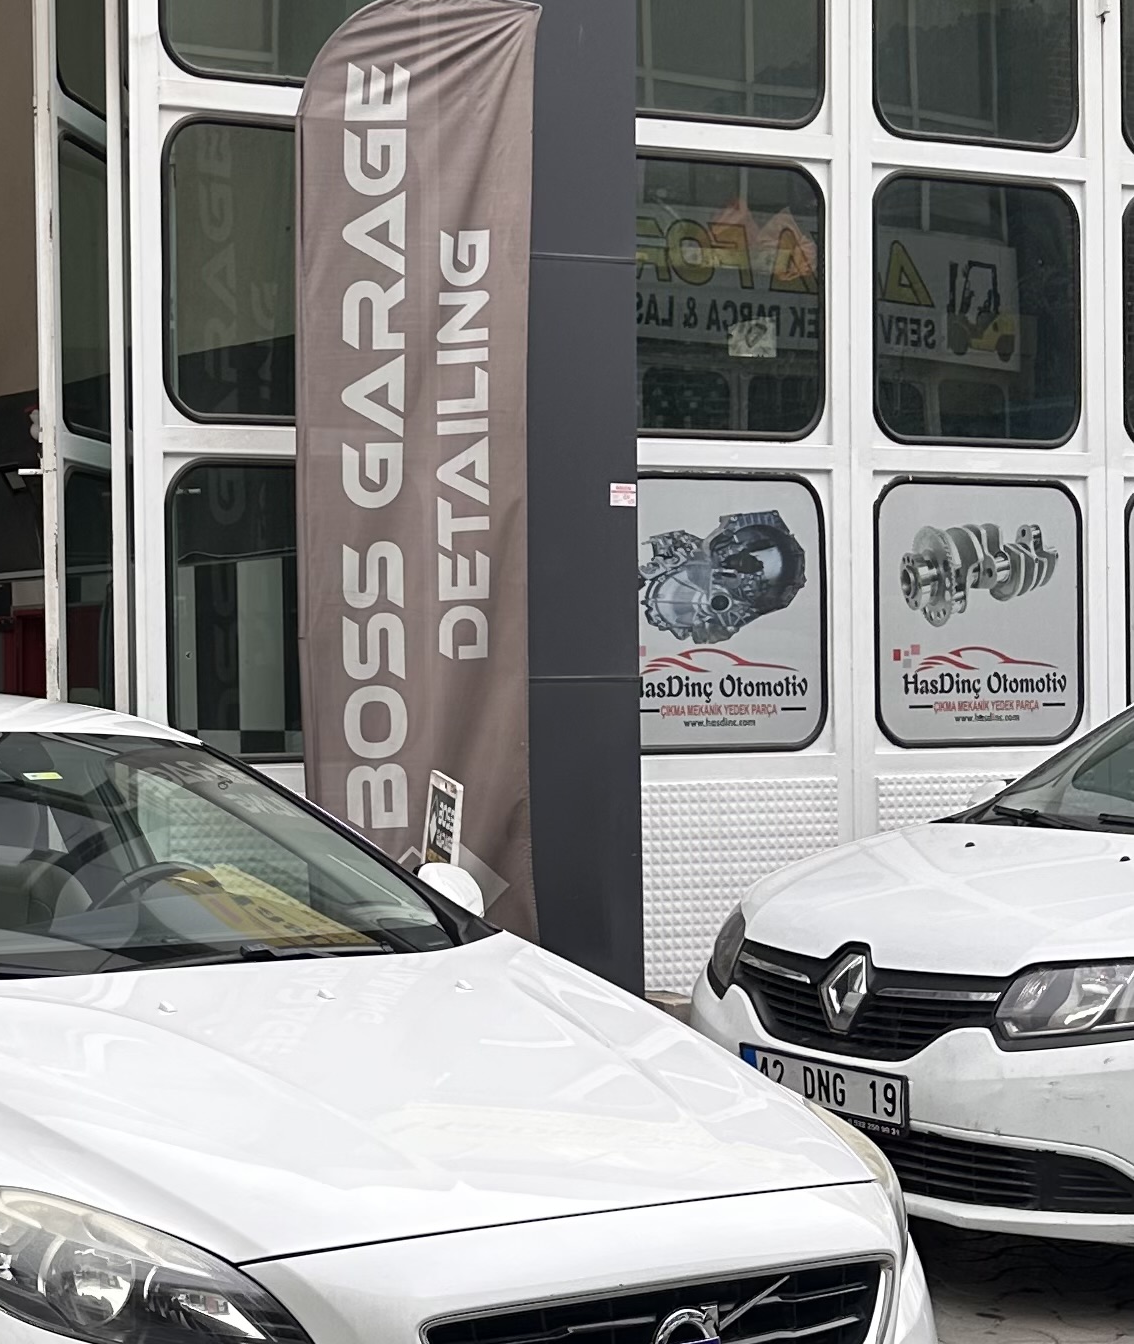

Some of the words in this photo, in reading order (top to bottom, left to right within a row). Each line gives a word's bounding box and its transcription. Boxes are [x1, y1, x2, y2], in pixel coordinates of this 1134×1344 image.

[340, 61, 411, 509] GARAGE
[433, 228, 491, 661] DETAILING
[340, 540, 409, 832] BOSS
[719, 674, 808, 698] Otomotiv
[724, 703, 750, 717] YEDEK
[902, 671, 982, 700] HasDinç
[986, 671, 1067, 694] Otomotiv
[802, 1065, 846, 1107] DNG
[869, 1080, 896, 1117] 19
